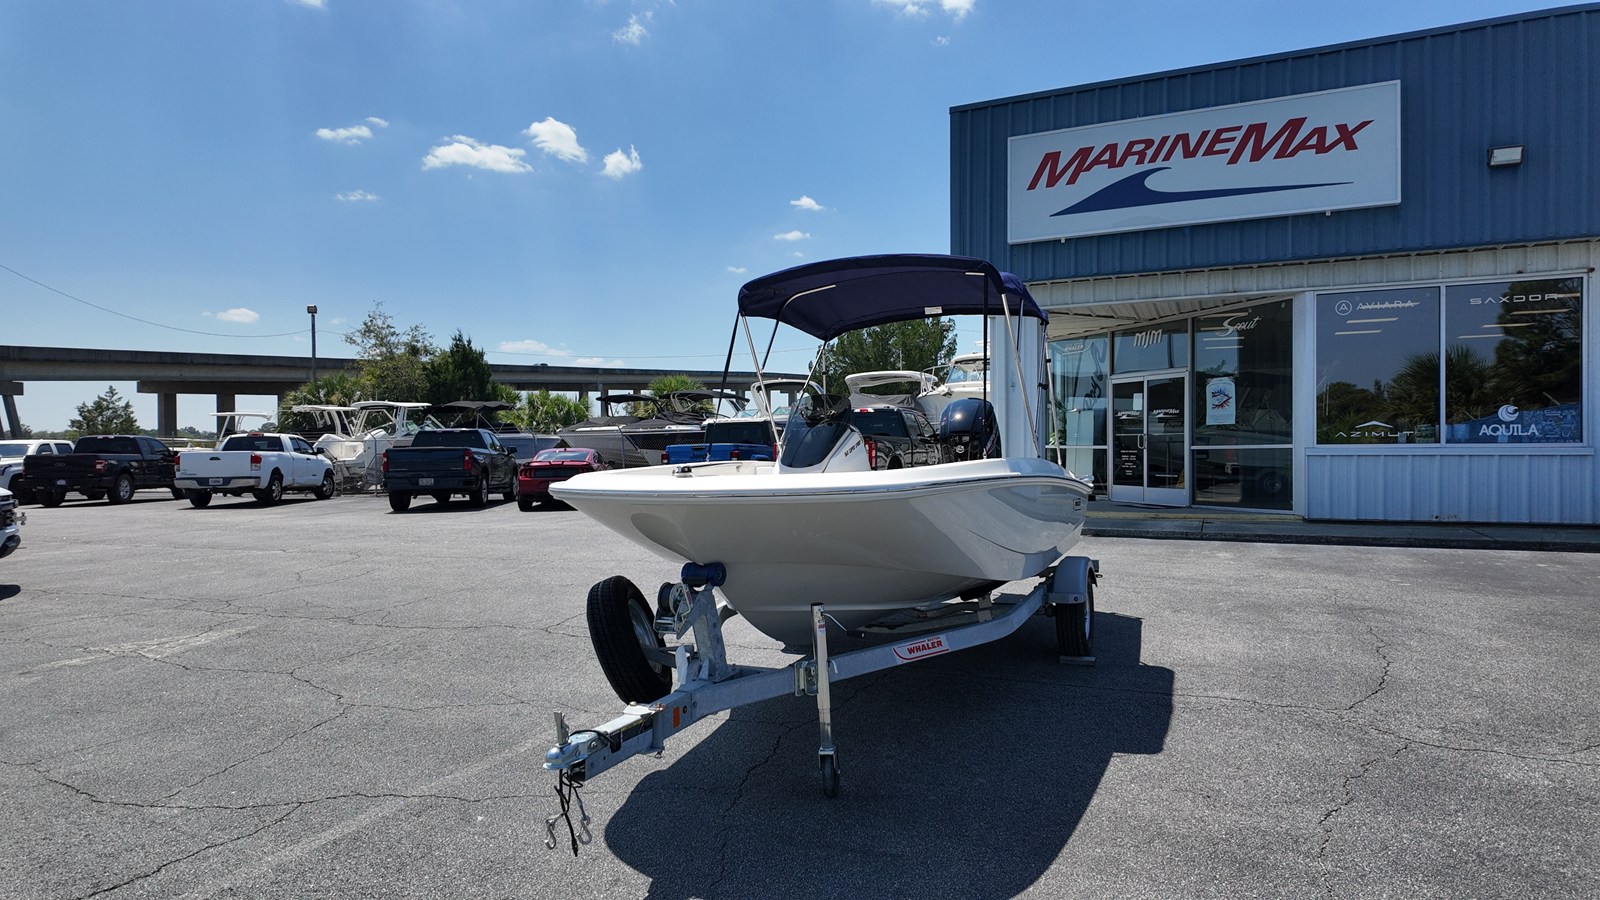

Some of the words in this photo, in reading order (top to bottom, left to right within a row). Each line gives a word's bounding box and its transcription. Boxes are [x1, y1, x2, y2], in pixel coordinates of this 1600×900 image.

[1356, 300, 1415, 311] AVIARA
[1214, 315, 1263, 337] Scout
[1133, 329, 1163, 349] MJM
[1335, 430, 1415, 438] AZIMUT
[1478, 424, 1539, 436] AQUILA
[907, 640, 943, 655] WHALER
